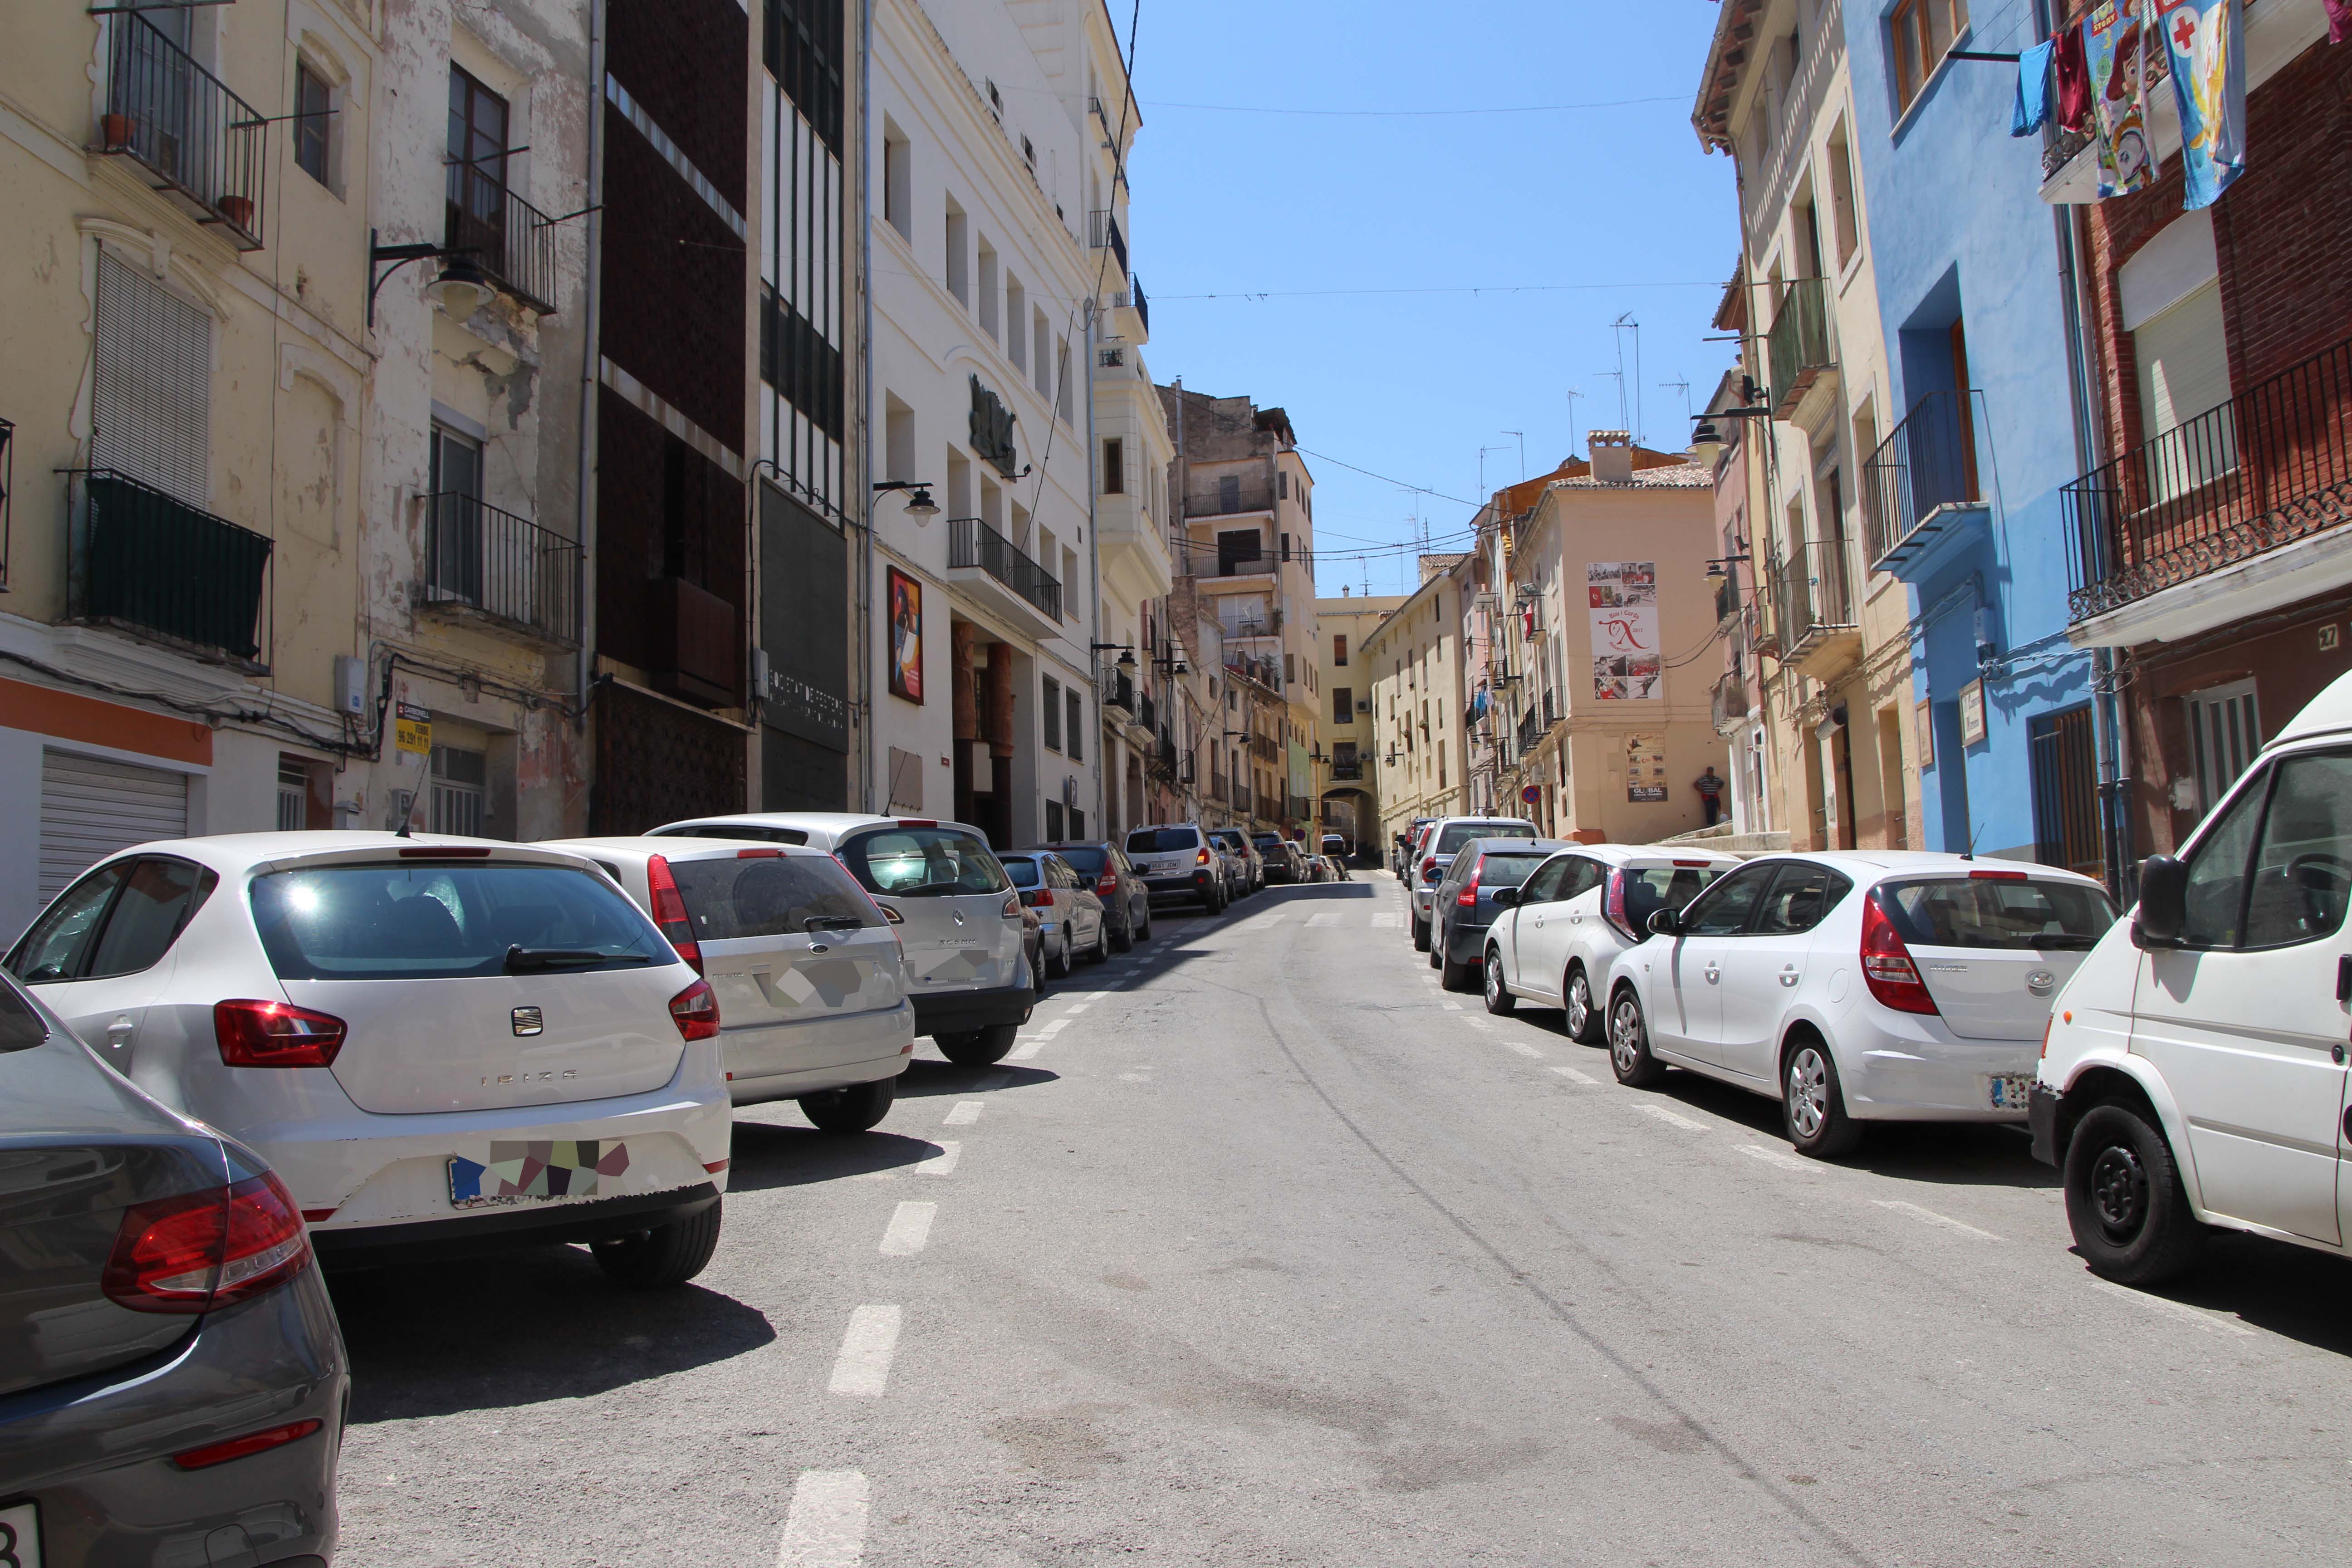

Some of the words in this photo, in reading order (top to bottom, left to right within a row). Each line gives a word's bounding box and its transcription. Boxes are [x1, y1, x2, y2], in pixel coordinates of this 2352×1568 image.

[2093, 13, 2115, 32] STORY
[2102, 28, 2112, 49] 3
[1624, 609, 1640, 620] Corda
[2319, 626, 2336, 648] 27
[805, 686, 813, 703] DE
[816, 690, 843, 715] FESTERS
[398, 730, 406, 743] 96
[407, 731, 416, 745] 291
[417, 735, 422, 747] 11
[424, 736, 429, 749] 11
[415, 724, 429, 736] VENDE
[481, 1069, 577, 1087] IBIZA
